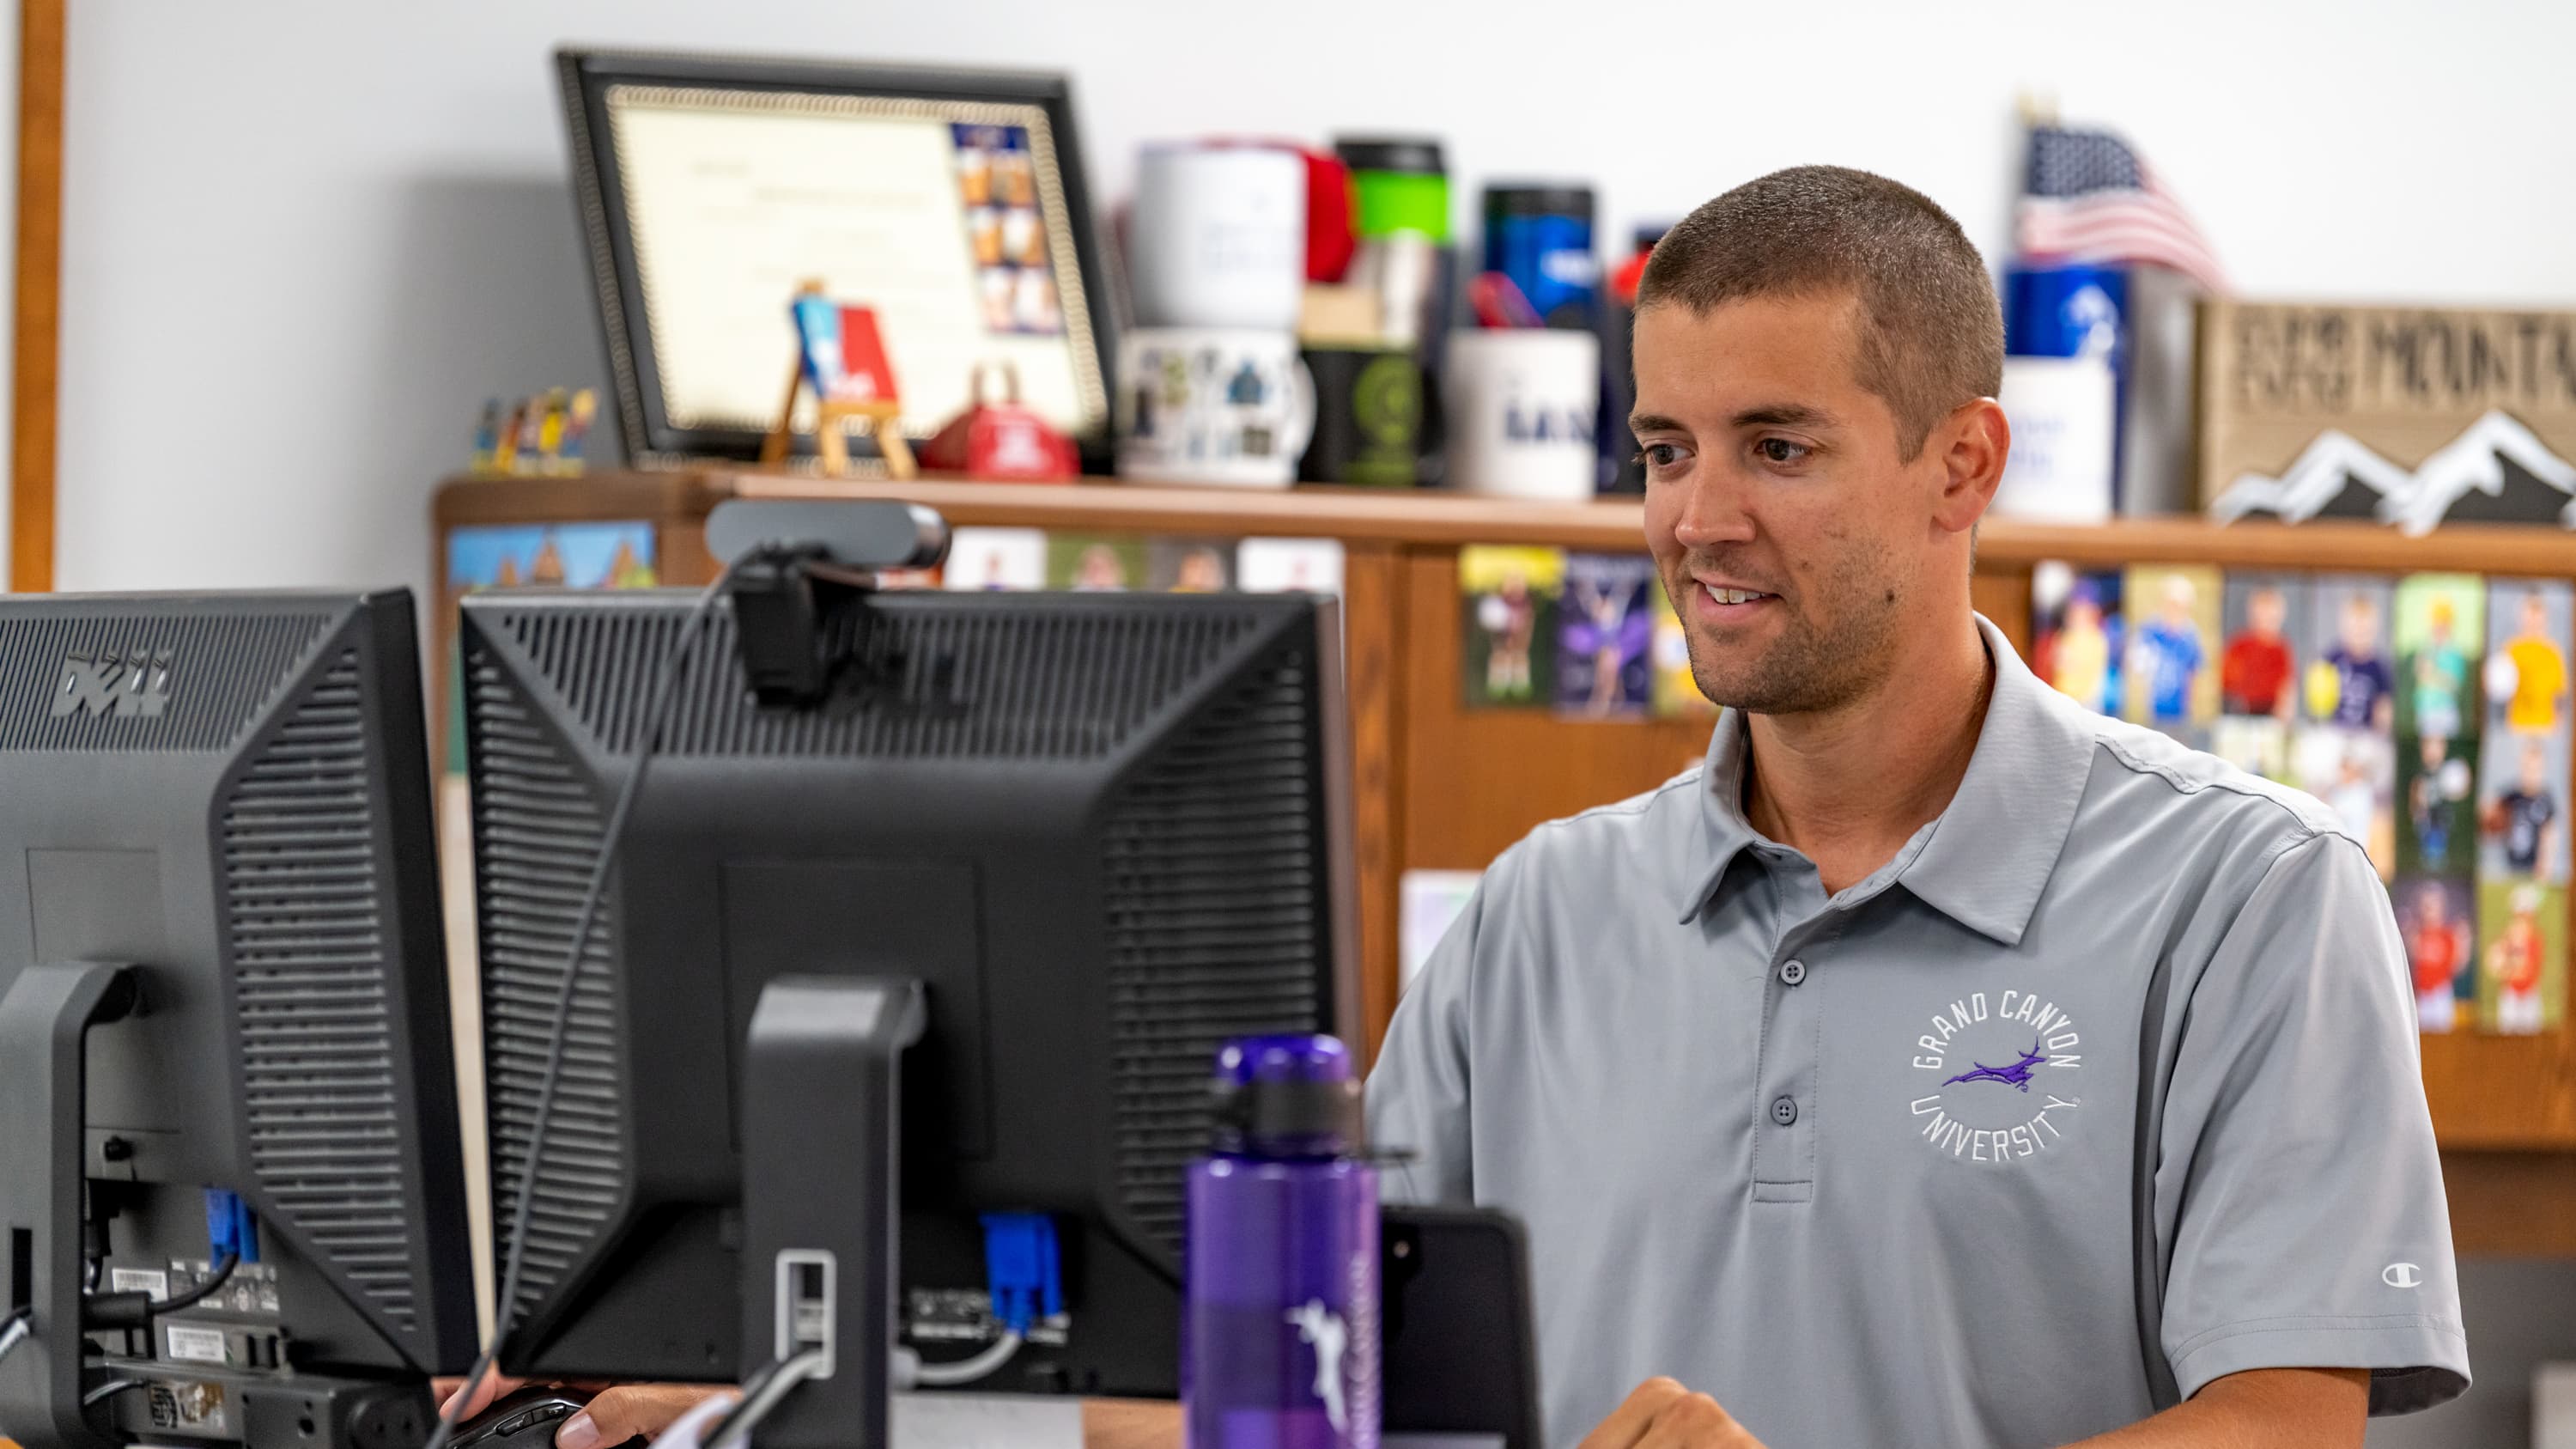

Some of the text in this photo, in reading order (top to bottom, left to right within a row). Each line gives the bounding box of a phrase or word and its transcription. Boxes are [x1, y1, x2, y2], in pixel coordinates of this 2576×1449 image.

[54, 649, 172, 717] DELL
[1912, 989, 2082, 1069] GRAND CANYON
[1910, 1093, 2079, 1163] UNIVERSITY
